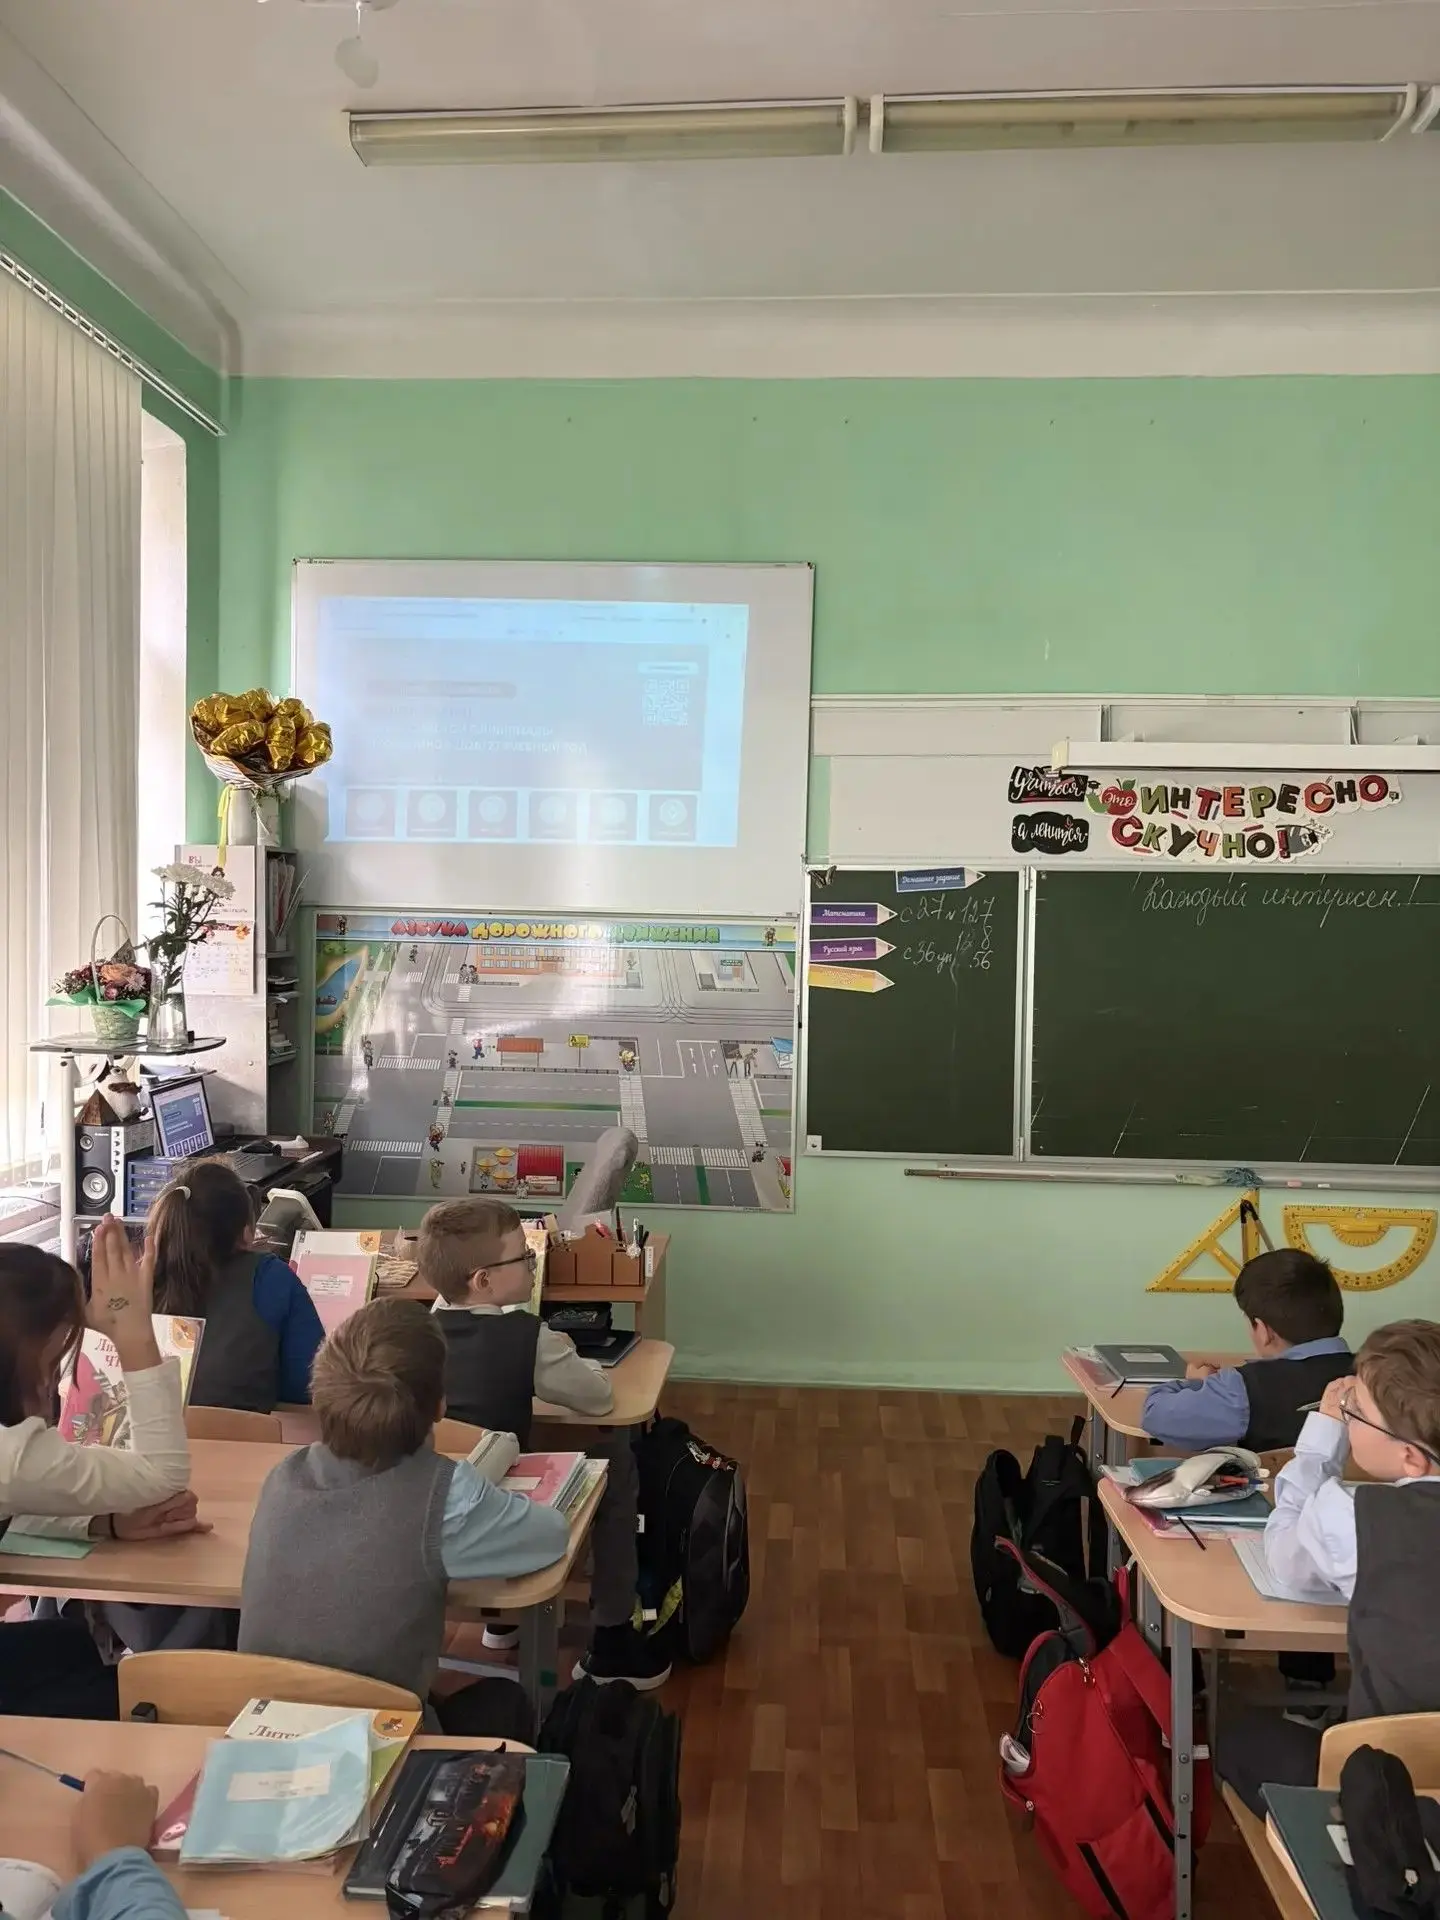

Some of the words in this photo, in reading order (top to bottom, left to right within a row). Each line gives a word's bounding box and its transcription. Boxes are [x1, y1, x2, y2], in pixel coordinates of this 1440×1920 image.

[1011, 768, 1085, 800] Учиться
[1111, 815, 1292, 859] СКУЧНО!
[822, 908, 866, 917] Математика
[917, 893, 945, 920] 27
[1142, 876, 1247, 926] Каждый
[391, 918, 469, 937] АЗБУКА
[822, 945, 847, 956] Русский
